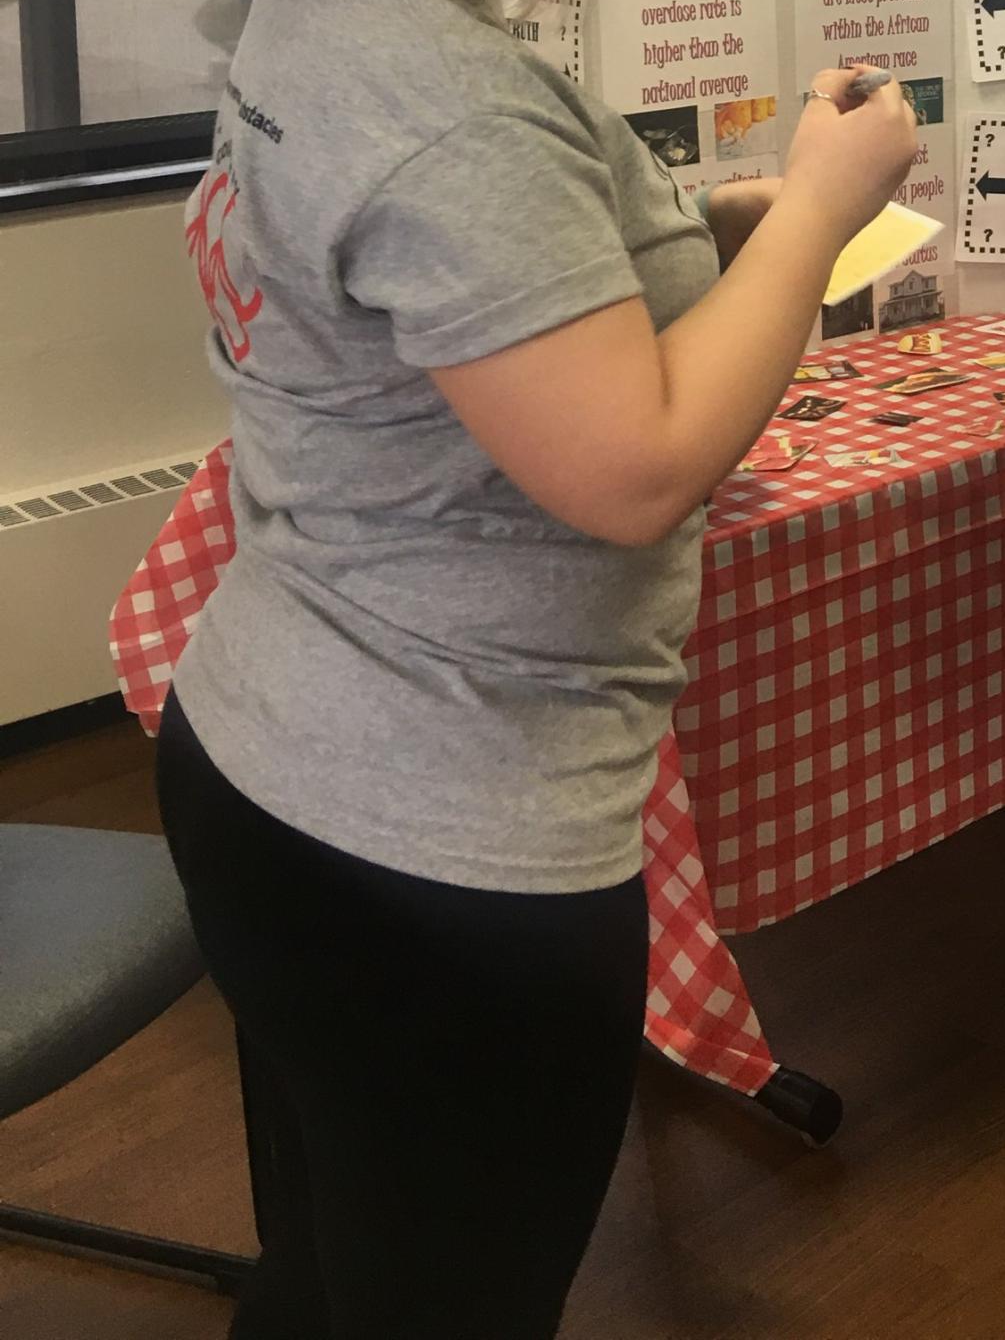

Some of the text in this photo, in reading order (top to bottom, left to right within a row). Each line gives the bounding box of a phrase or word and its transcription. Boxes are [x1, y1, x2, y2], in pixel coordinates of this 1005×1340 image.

[642, 0, 696, 26] overdose
[822, 13, 929, 41] within the African
[643, 33, 743, 69] higher than the
[893, 50, 917, 68] race
[642, 74, 749, 105] national average
[910, 174, 944, 205] people
